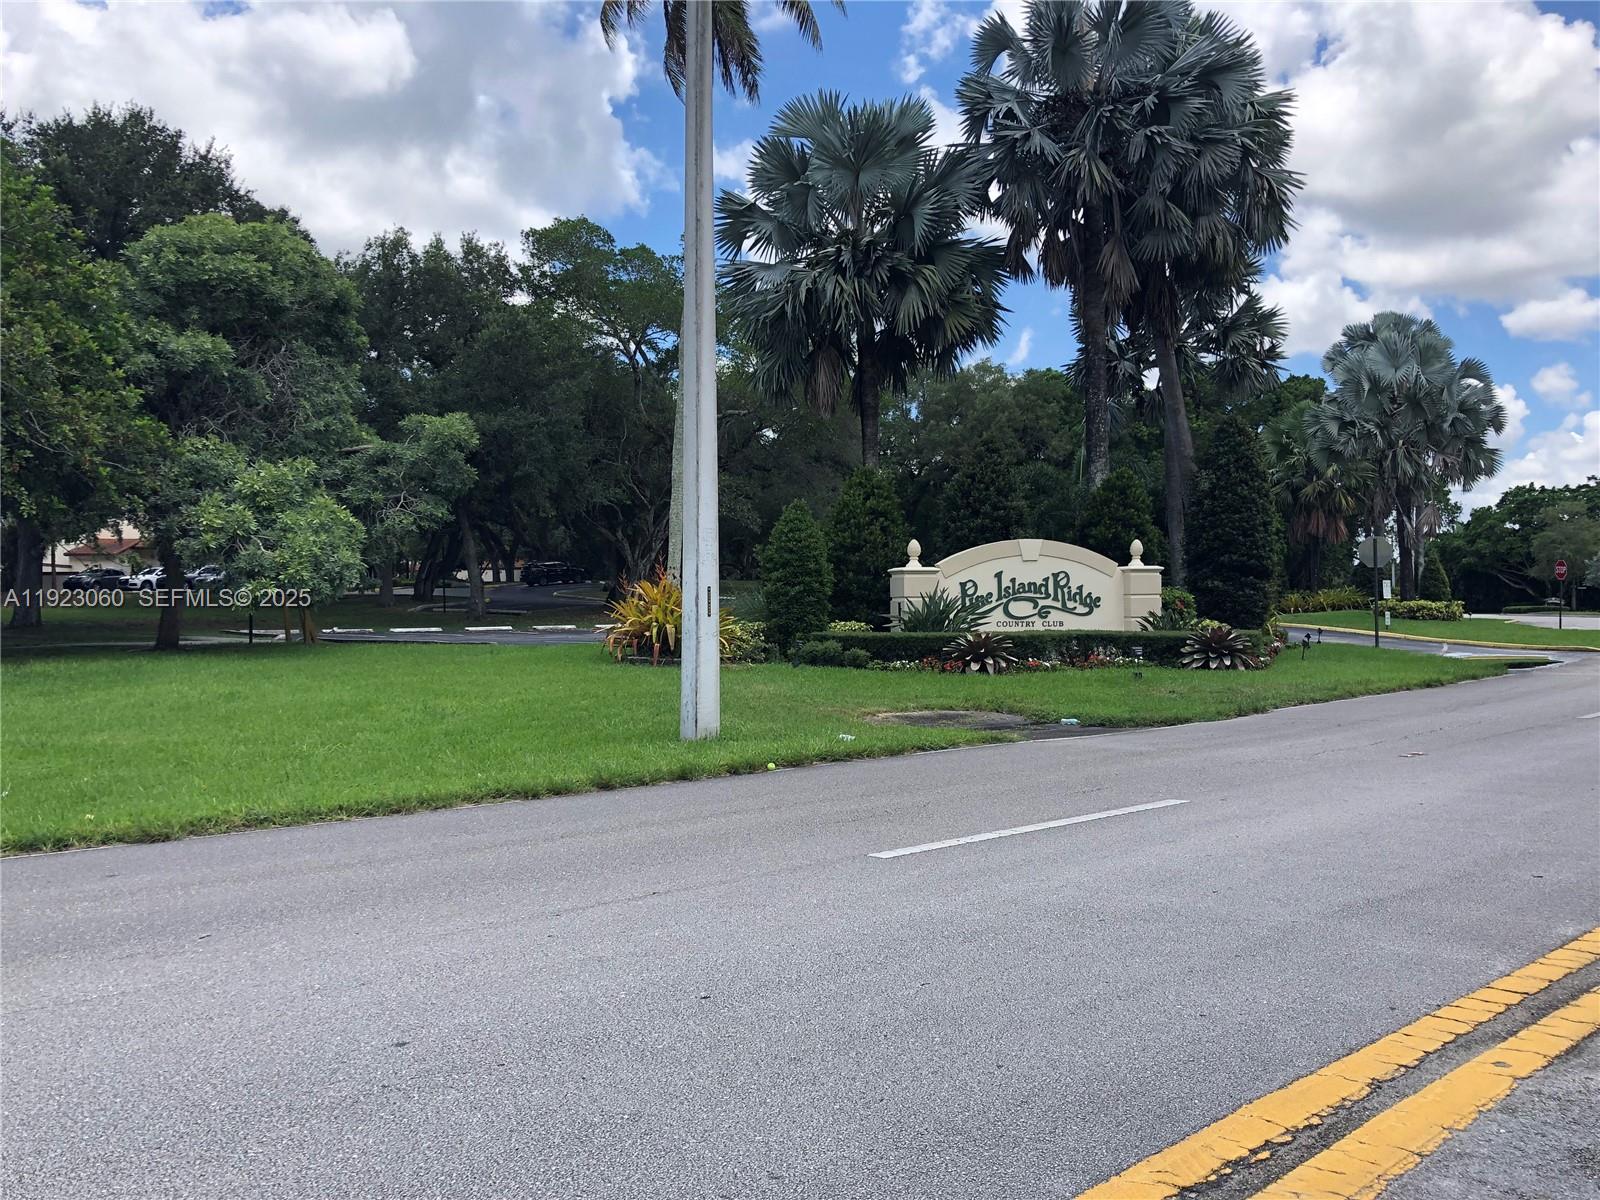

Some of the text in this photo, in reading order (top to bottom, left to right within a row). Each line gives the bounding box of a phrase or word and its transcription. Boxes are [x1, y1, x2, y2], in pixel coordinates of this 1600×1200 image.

[994, 570, 1051, 600] Island
[1051, 570, 1101, 616] Ridge
[996, 620, 1064, 628] COUNTRY CLUB
